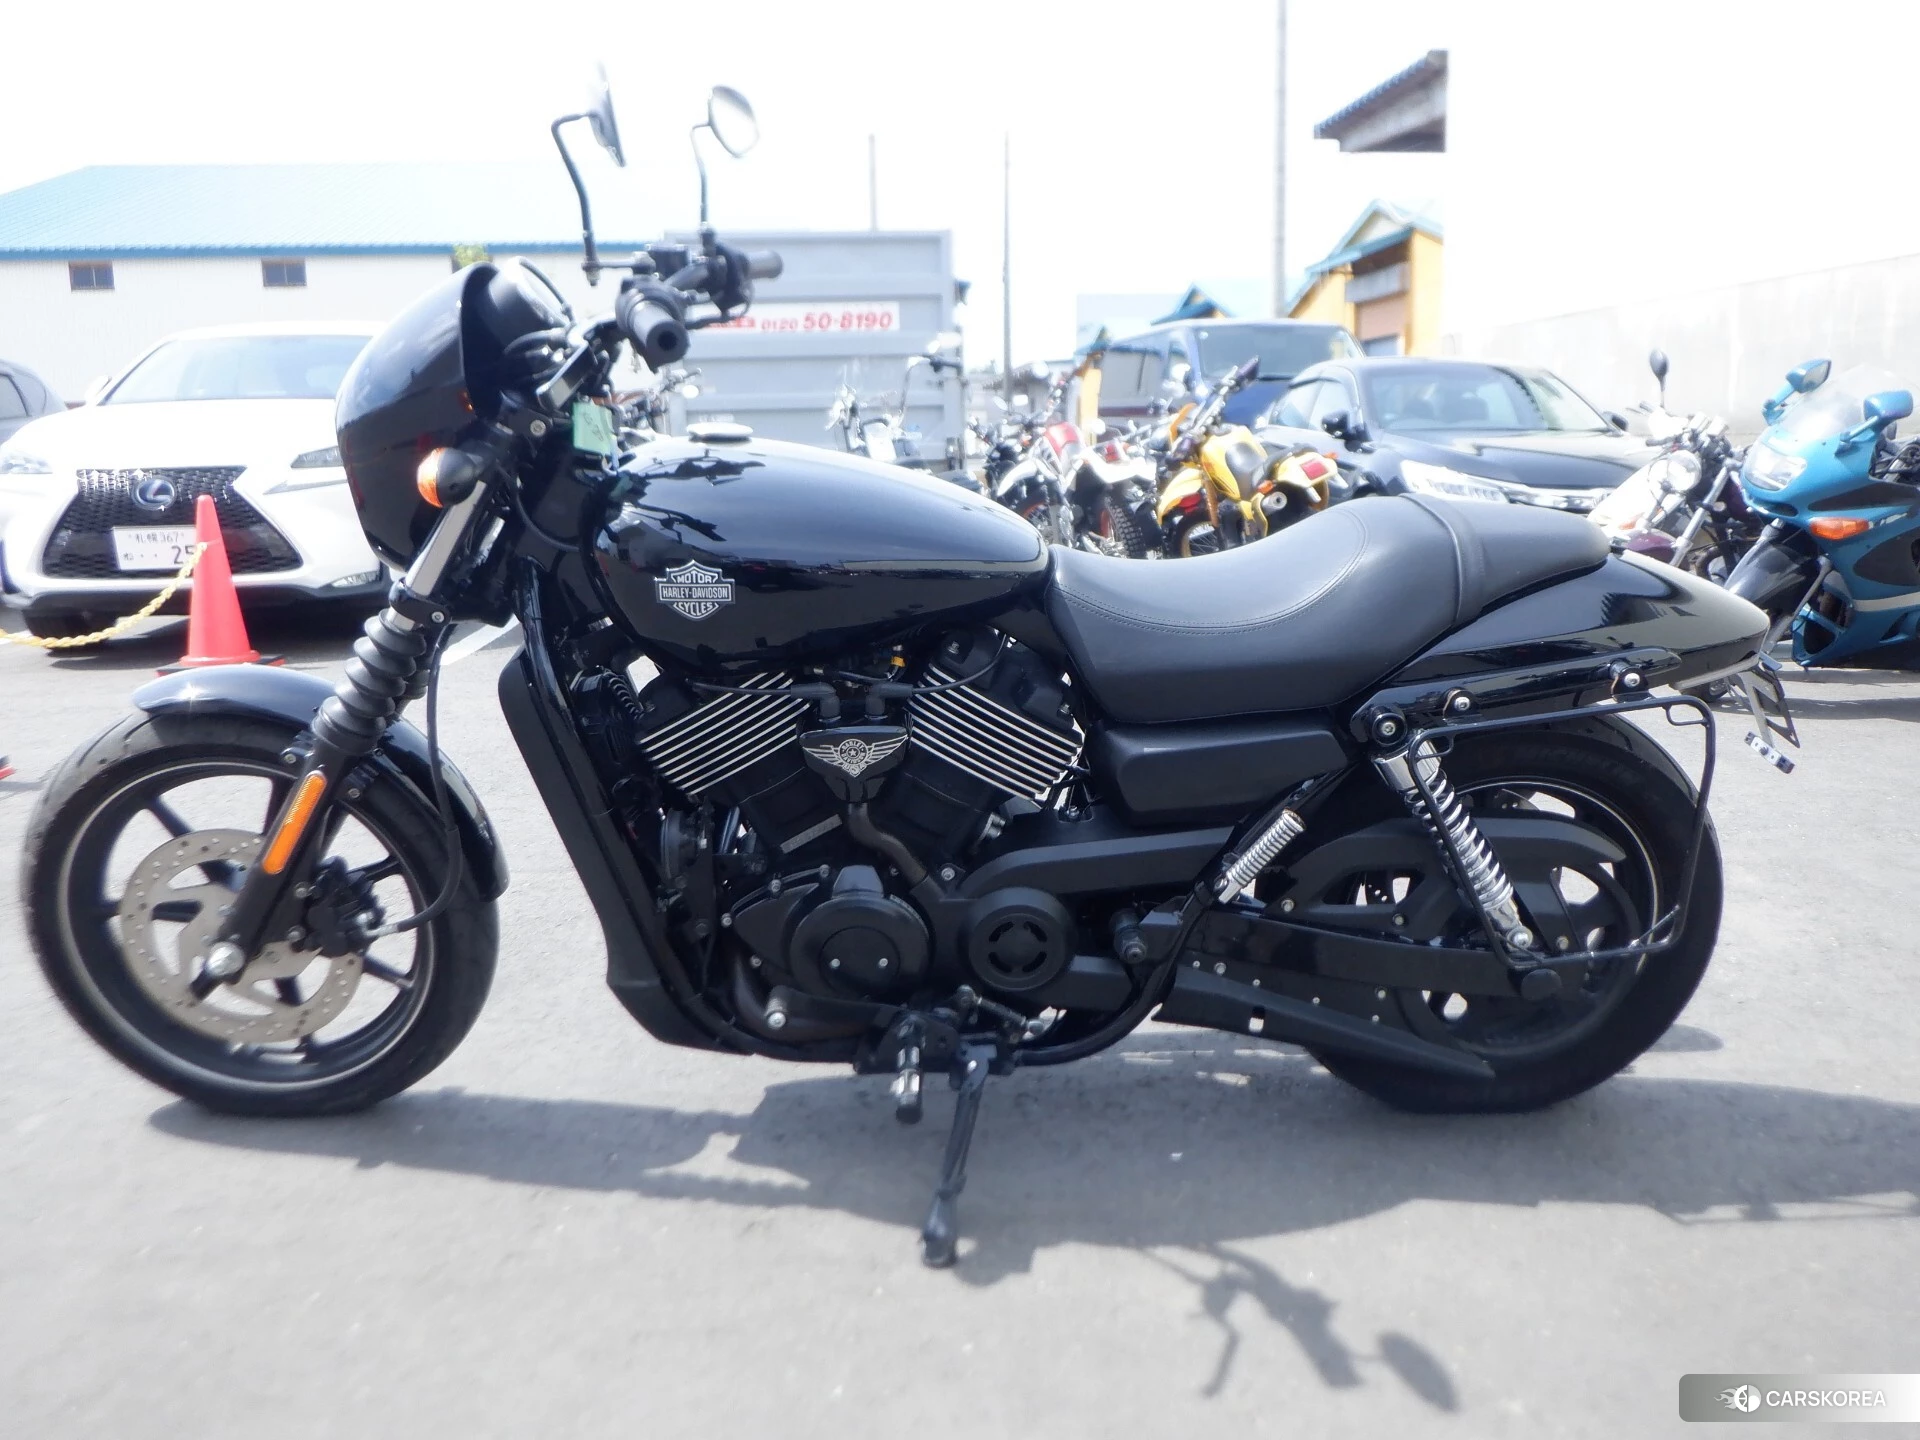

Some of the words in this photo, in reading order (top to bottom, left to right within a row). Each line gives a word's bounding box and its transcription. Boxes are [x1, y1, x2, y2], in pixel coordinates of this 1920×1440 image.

[677, 570, 712, 583] MOTOR
[662, 587, 728, 599] HARLEY-DAVIDSON
[678, 602, 713, 616] CYCLES
